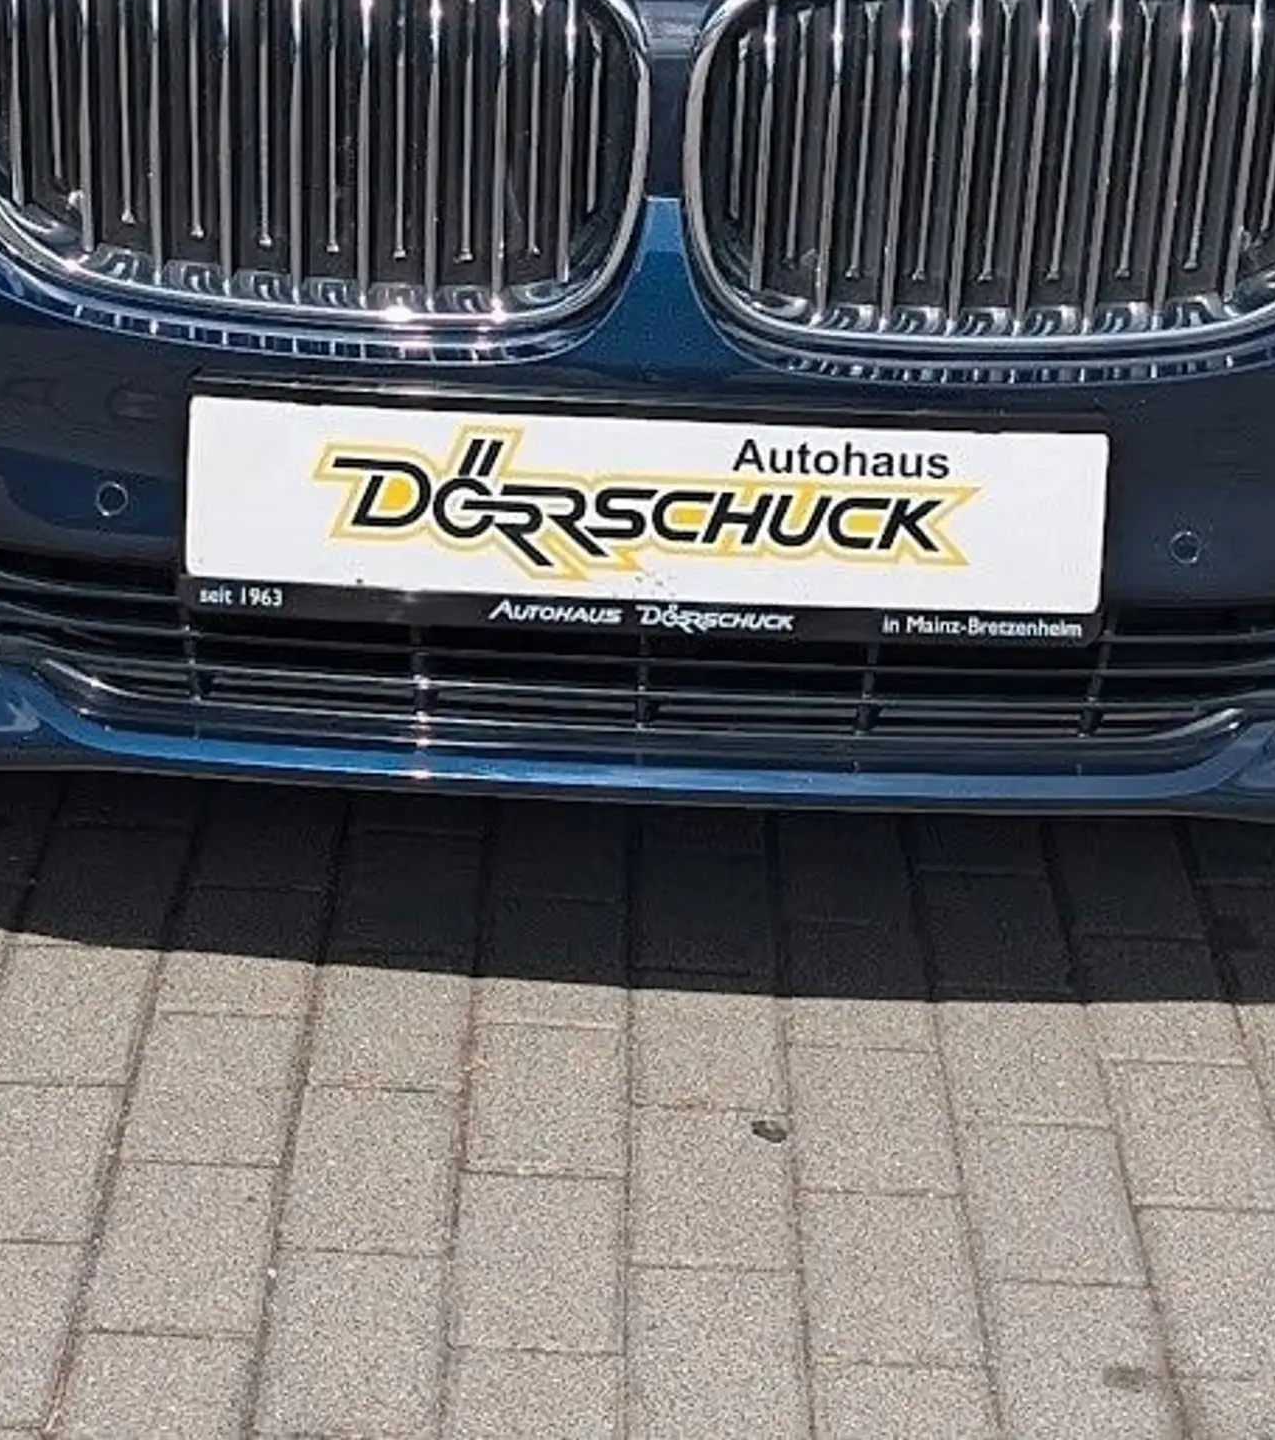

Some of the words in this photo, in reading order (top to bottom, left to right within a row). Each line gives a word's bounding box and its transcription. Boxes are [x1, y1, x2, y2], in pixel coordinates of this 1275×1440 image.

[732, 439, 950, 479] Autohaus
[332, 438, 942, 566] DÖRRSCHUCK
[240, 587, 283, 606] 1963
